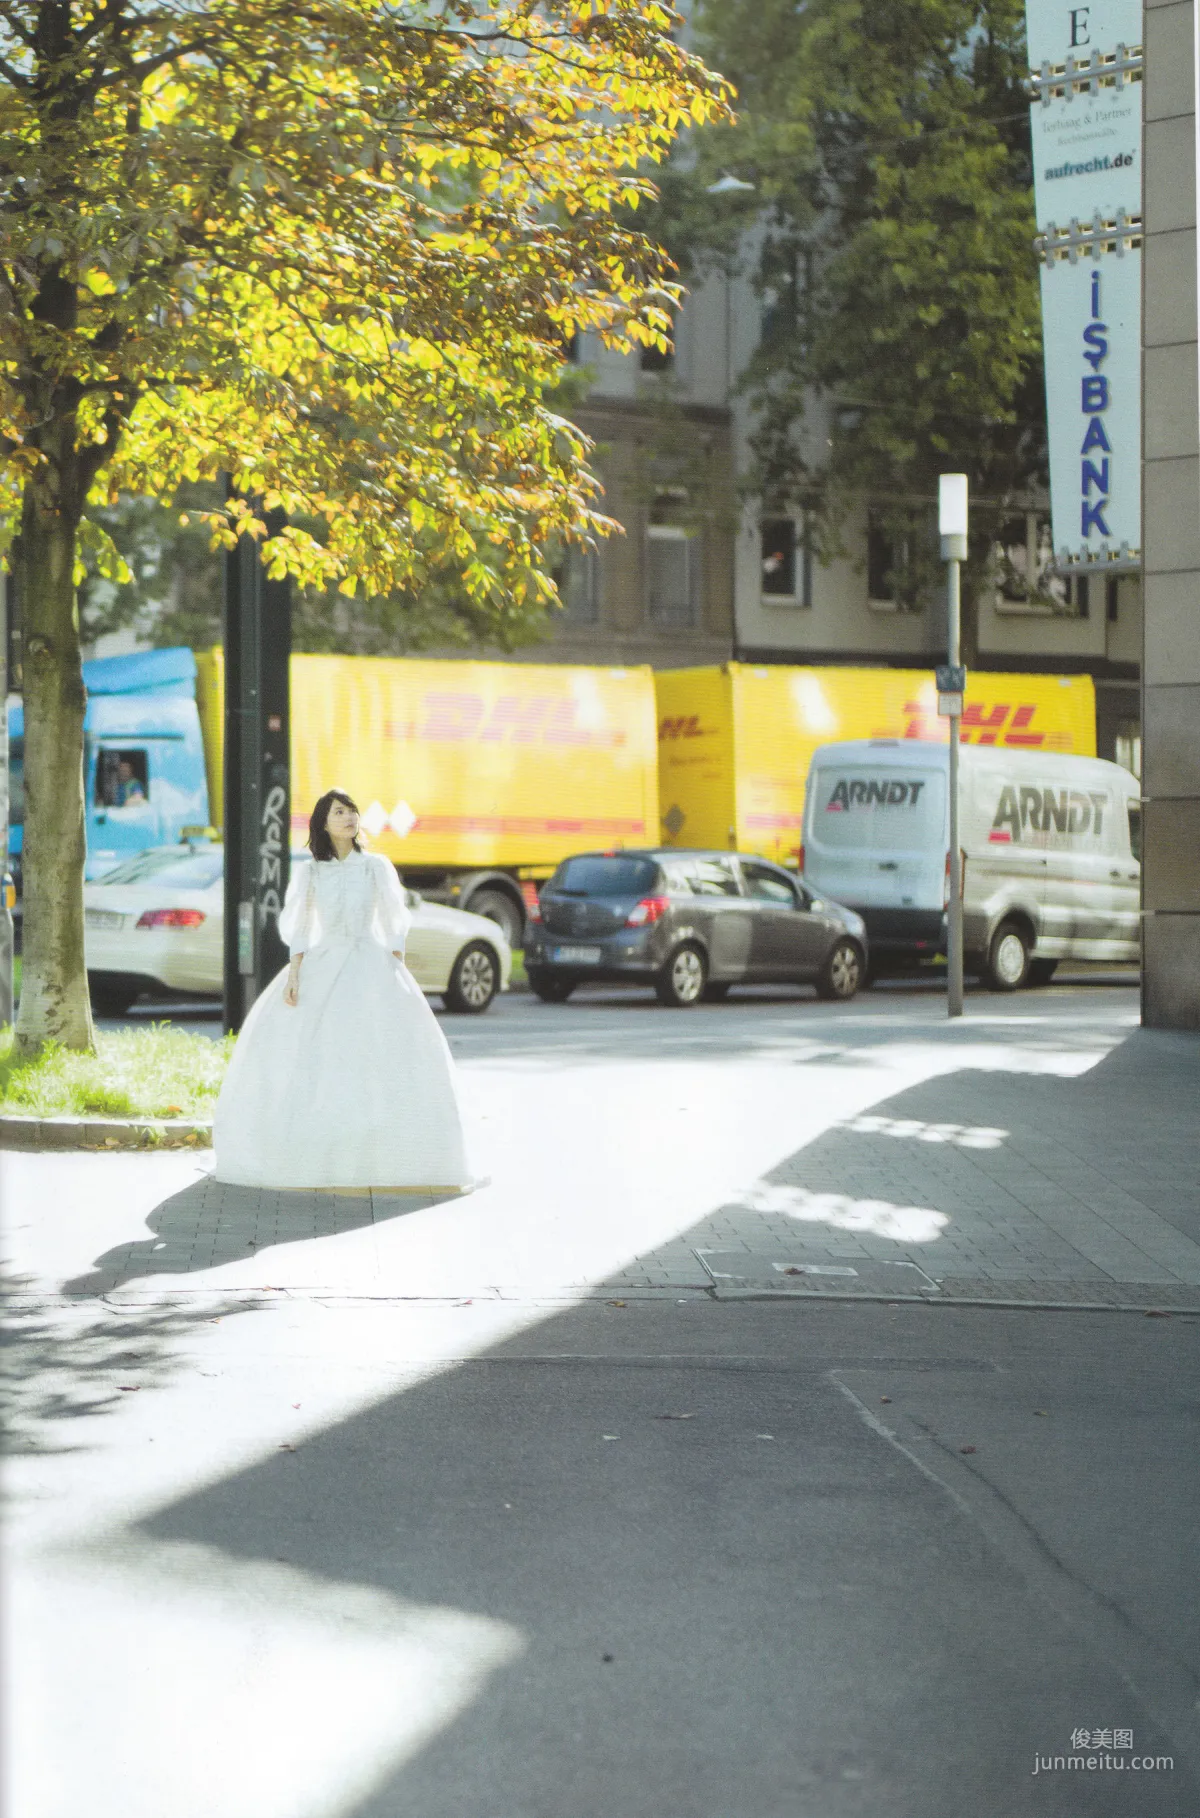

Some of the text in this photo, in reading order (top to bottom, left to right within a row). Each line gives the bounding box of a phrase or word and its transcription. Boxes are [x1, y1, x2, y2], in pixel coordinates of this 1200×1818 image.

[1044, 152, 1133, 181] aufrecht.de
[420, 691, 592, 743] DHL
[826, 779, 925, 812] ARNDT
[988, 784, 1108, 843] ARNDT
